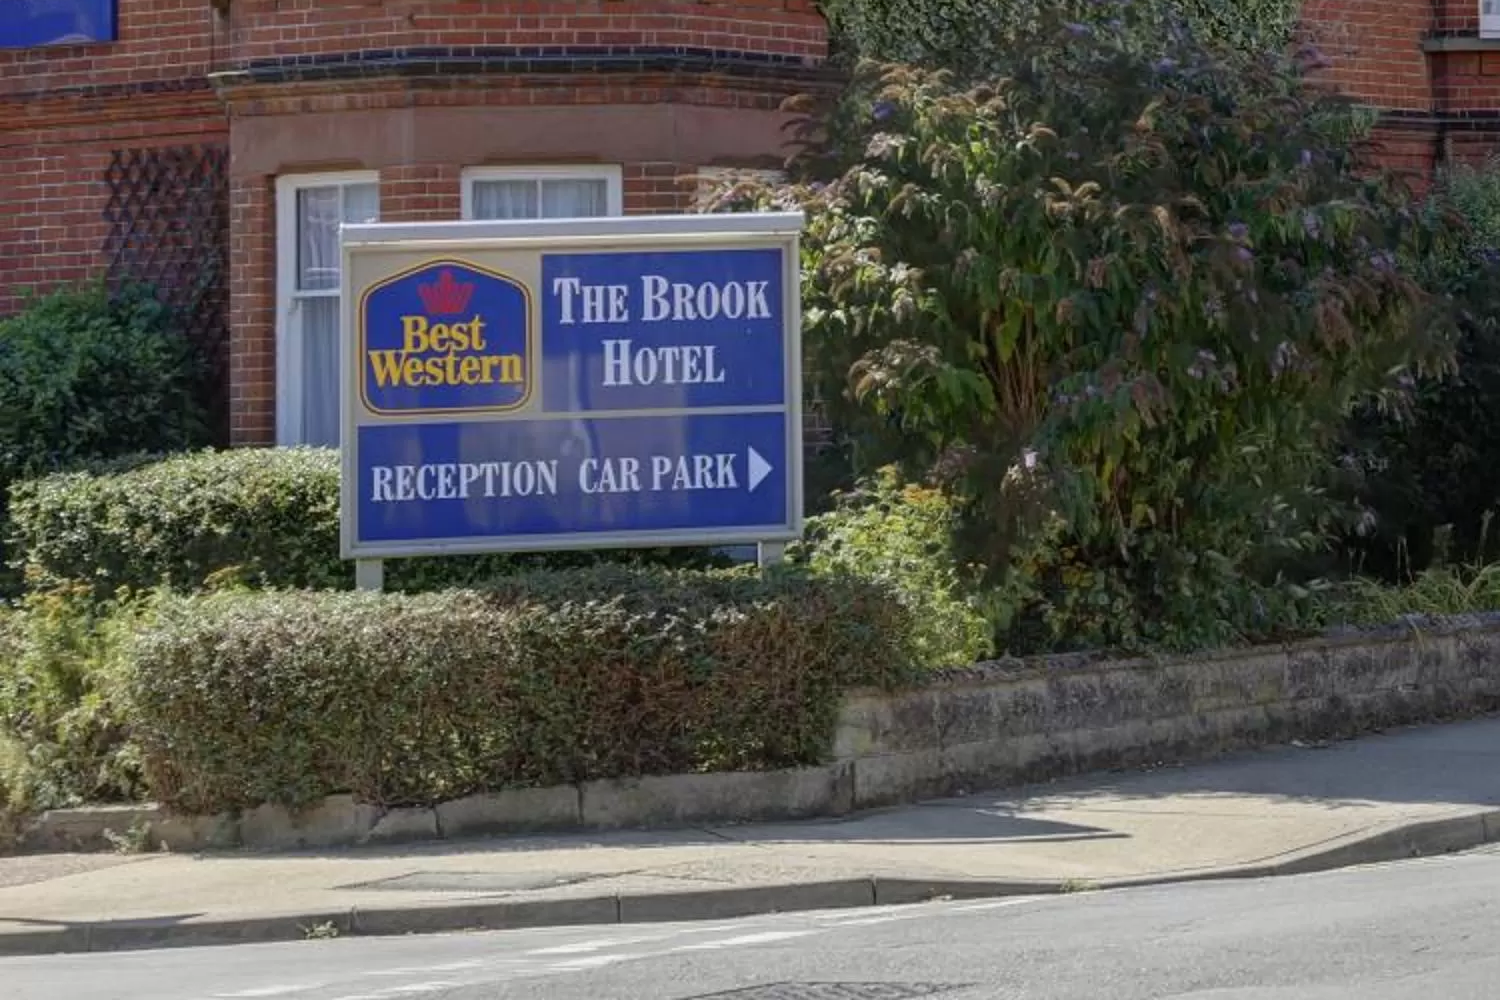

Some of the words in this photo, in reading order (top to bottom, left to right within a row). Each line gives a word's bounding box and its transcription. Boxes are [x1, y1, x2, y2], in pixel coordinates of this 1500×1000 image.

[553, 277, 629, 324] THE
[641, 275, 772, 322] BROOK
[400, 313, 487, 353] Best
[368, 350, 524, 388] Western
[602, 339, 726, 386] HOTEL
[371, 459, 559, 502] RECEPTION
[579, 457, 642, 494] CAR
[651, 453, 738, 493] PARK
